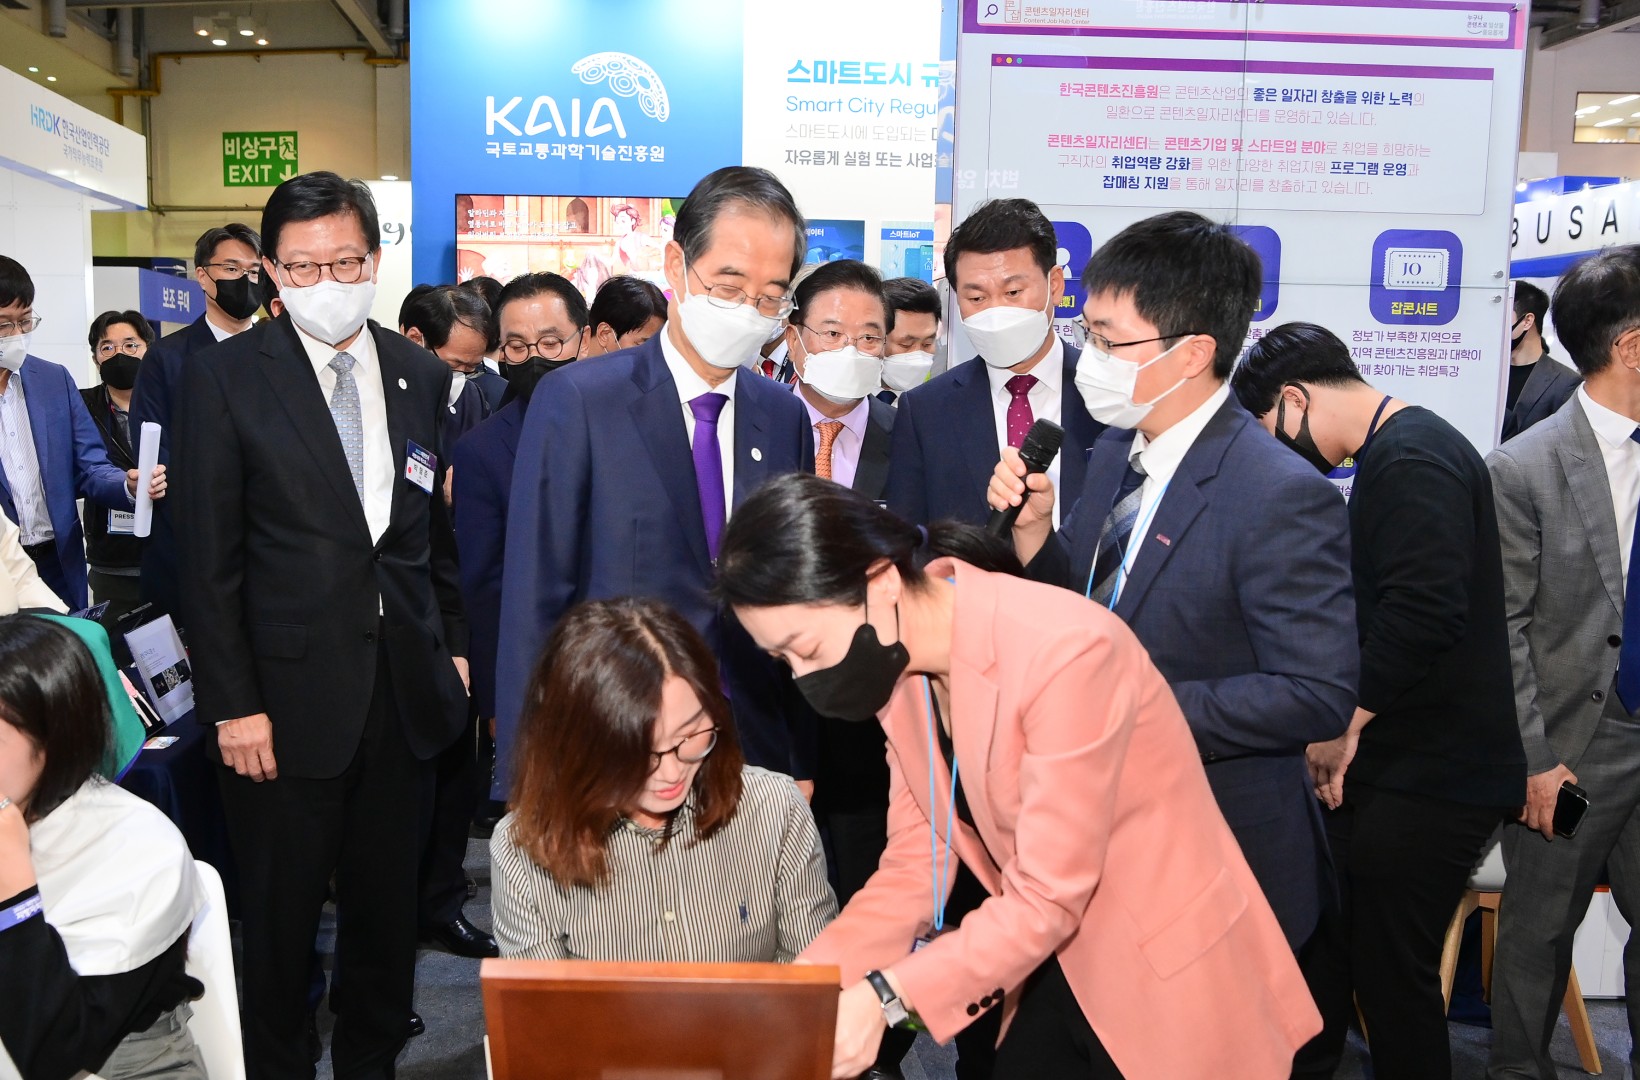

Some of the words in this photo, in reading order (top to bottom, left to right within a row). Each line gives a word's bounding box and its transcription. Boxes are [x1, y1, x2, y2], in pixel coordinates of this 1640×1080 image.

[1024, 7, 1090, 18] 콘텐츠일자리센터
[787, 60, 911, 86] 스마트도시
[1060, 83, 1171, 99] 한국콘텐츠진흥원은
[1175, 86, 1248, 101] 콘텐츠산업의
[1253, 88, 1277, 102] 좋은
[1282, 88, 1317, 103] 일자리
[1321, 89, 1357, 104] 창출을
[1361, 91, 1385, 105] 위한
[1389, 92, 1425, 106] 노력의
[486, 95, 626, 138] KAIA
[786, 96, 843, 112] Smart
[848, 97, 885, 117] City
[1106, 105, 1155, 120] 일환으로
[1160, 106, 1270, 123] 콘텐츠일자리센터를
[1274, 110, 1322, 124] 운영하고
[1327, 110, 1377, 126] 있습니다.
[31, 104, 61, 136] HRDK
[786, 124, 868, 140] 스마트도시에
[872, 125, 927, 142] 도입되는
[225, 136, 277, 159] 비상구
[486, 141, 665, 162] 국토교통과학기술진흥원
[1048, 134, 1159, 150] 콘텐츠일자리센터는
[1164, 137, 1227, 152] 콘텐츠기업
[1231, 138, 1243, 152] 및
[1247, 139, 1297, 153] 스타트업
[1301, 140, 1337, 154] 분야로
[1342, 142, 1378, 156] 취업을
[1382, 142, 1430, 157] 희망하는
[785, 150, 839, 166] 자유롭게
[844, 151, 870, 167] 실험
[875, 151, 902, 168] 또는
[906, 152, 938, 168] 사업
[1057, 154, 1107, 169] 구직자의
[1112, 155, 1162, 170] 취업역량
[1166, 156, 1203, 171] 강화를
[1207, 157, 1232, 172] 위한
[1236, 158, 1273, 172] 다양한
[1278, 160, 1325, 174] 취업지원
[1330, 161, 1379, 175] 프로그램
[1383, 162, 1419, 177] 운영과
[229, 164, 272, 183] EXIT
[1103, 175, 1140, 189] 잡매칭
[1144, 176, 1181, 190] 지원을
[1186, 177, 1210, 191] 통해
[1214, 178, 1264, 192] 일자리를
[1268, 179, 1317, 194] 창출하고
[1321, 180, 1373, 195] 있습니다.
[889, 230, 920, 238] 스마트IoT
[1402, 262, 1422, 276] JO
[163, 286, 176, 309] 보조
[178, 290, 190, 313] 무대
[1391, 301, 1438, 316] 잡콘서트
[1352, 330, 1384, 342] 정보가
[1386, 331, 1418, 343] 부족한
[1420, 332, 1462, 344] 지역으로
[1351, 347, 1372, 359] 지역
[1374, 347, 1448, 360] 콘텐츠진흥원과
[1450, 349, 1481, 361] 대학이
[1373, 364, 1415, 376] 찾아가는
[1418, 365, 1459, 378] 취업특강
